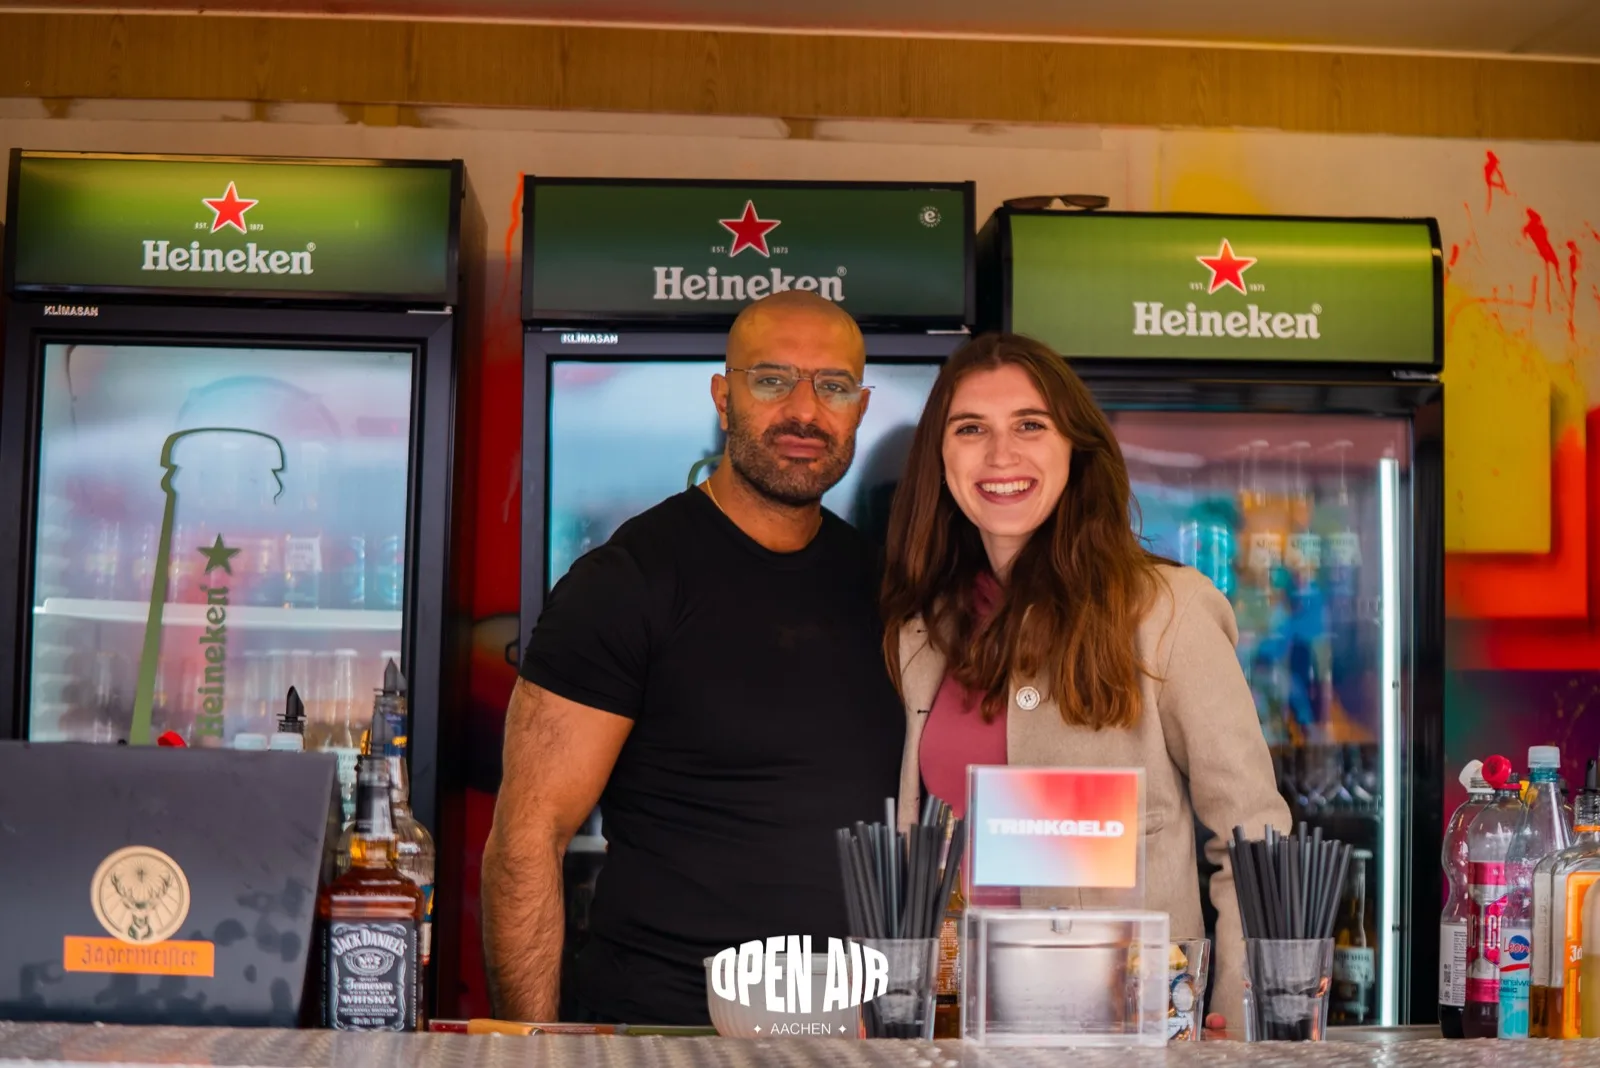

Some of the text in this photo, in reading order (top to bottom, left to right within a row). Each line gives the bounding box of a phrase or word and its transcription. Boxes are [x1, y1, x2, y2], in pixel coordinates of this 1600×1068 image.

[142, 240, 314, 275] Heineken
[773, 246, 789, 255] 1873
[1132, 301, 1321, 340] Heineken
[986, 818, 1125, 837] TRINKGELD
[331, 928, 408, 957] JACK DANIEL'S
[339, 994, 397, 1005] WHISKEY
